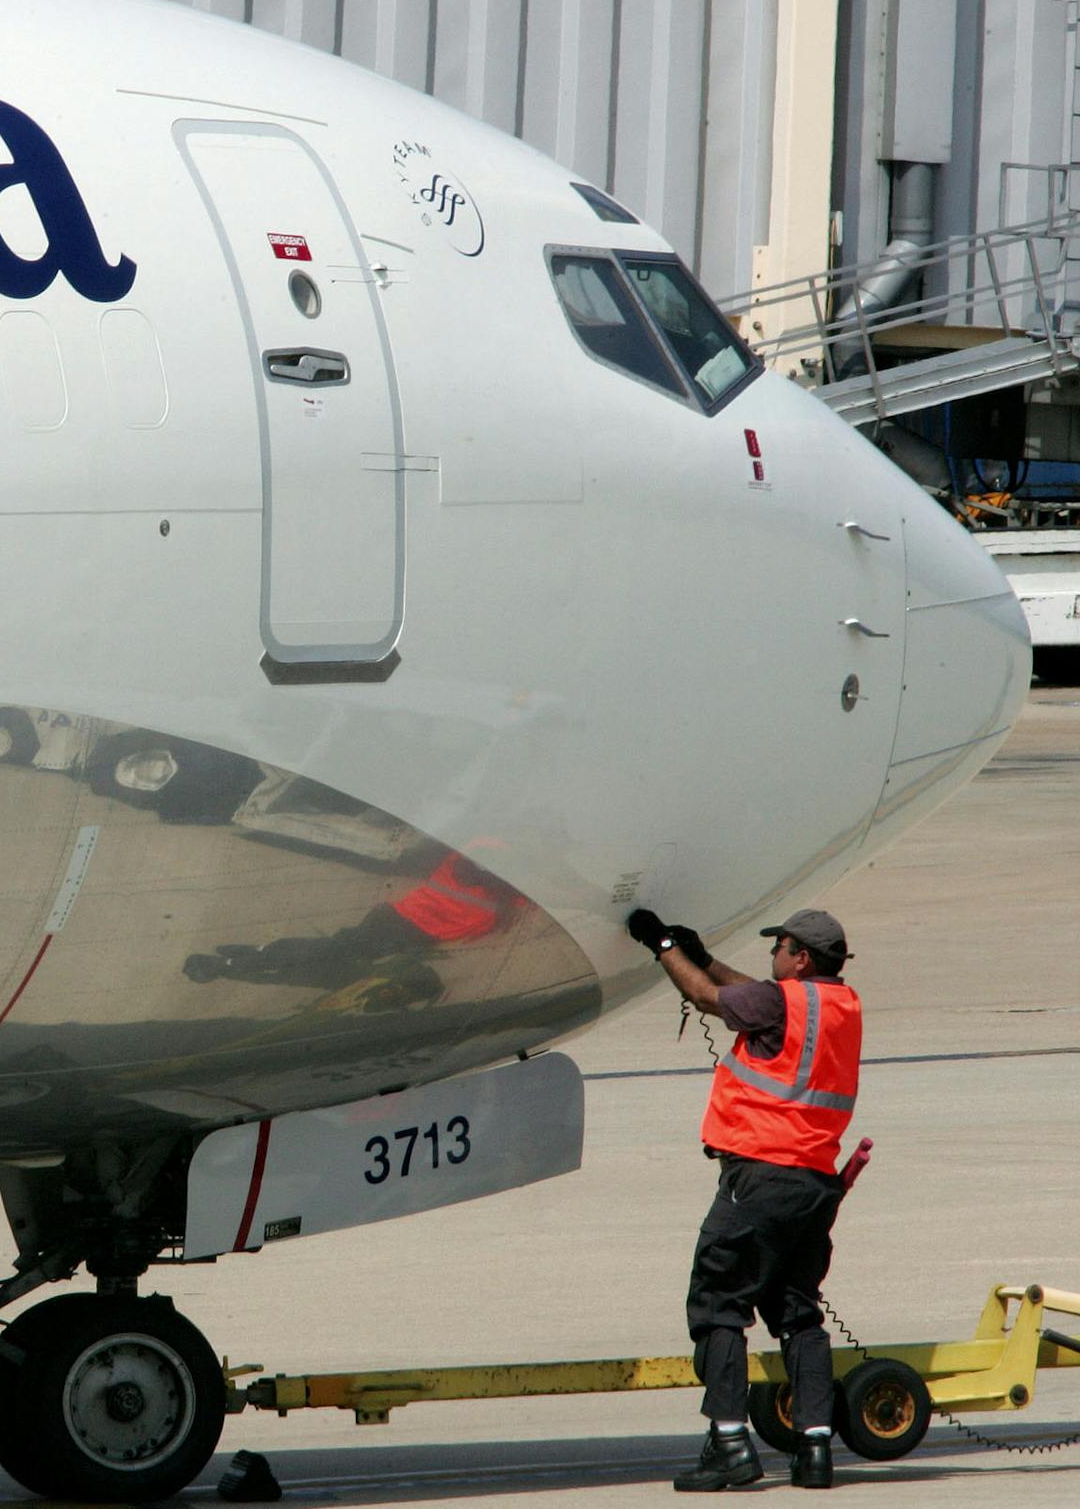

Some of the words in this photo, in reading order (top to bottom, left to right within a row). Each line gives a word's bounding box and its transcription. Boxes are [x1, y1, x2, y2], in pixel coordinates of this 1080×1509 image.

[269, 234, 306, 246] EMERGENCY
[284, 247, 299, 257] EXIT
[364, 1115, 471, 1185] 3713
